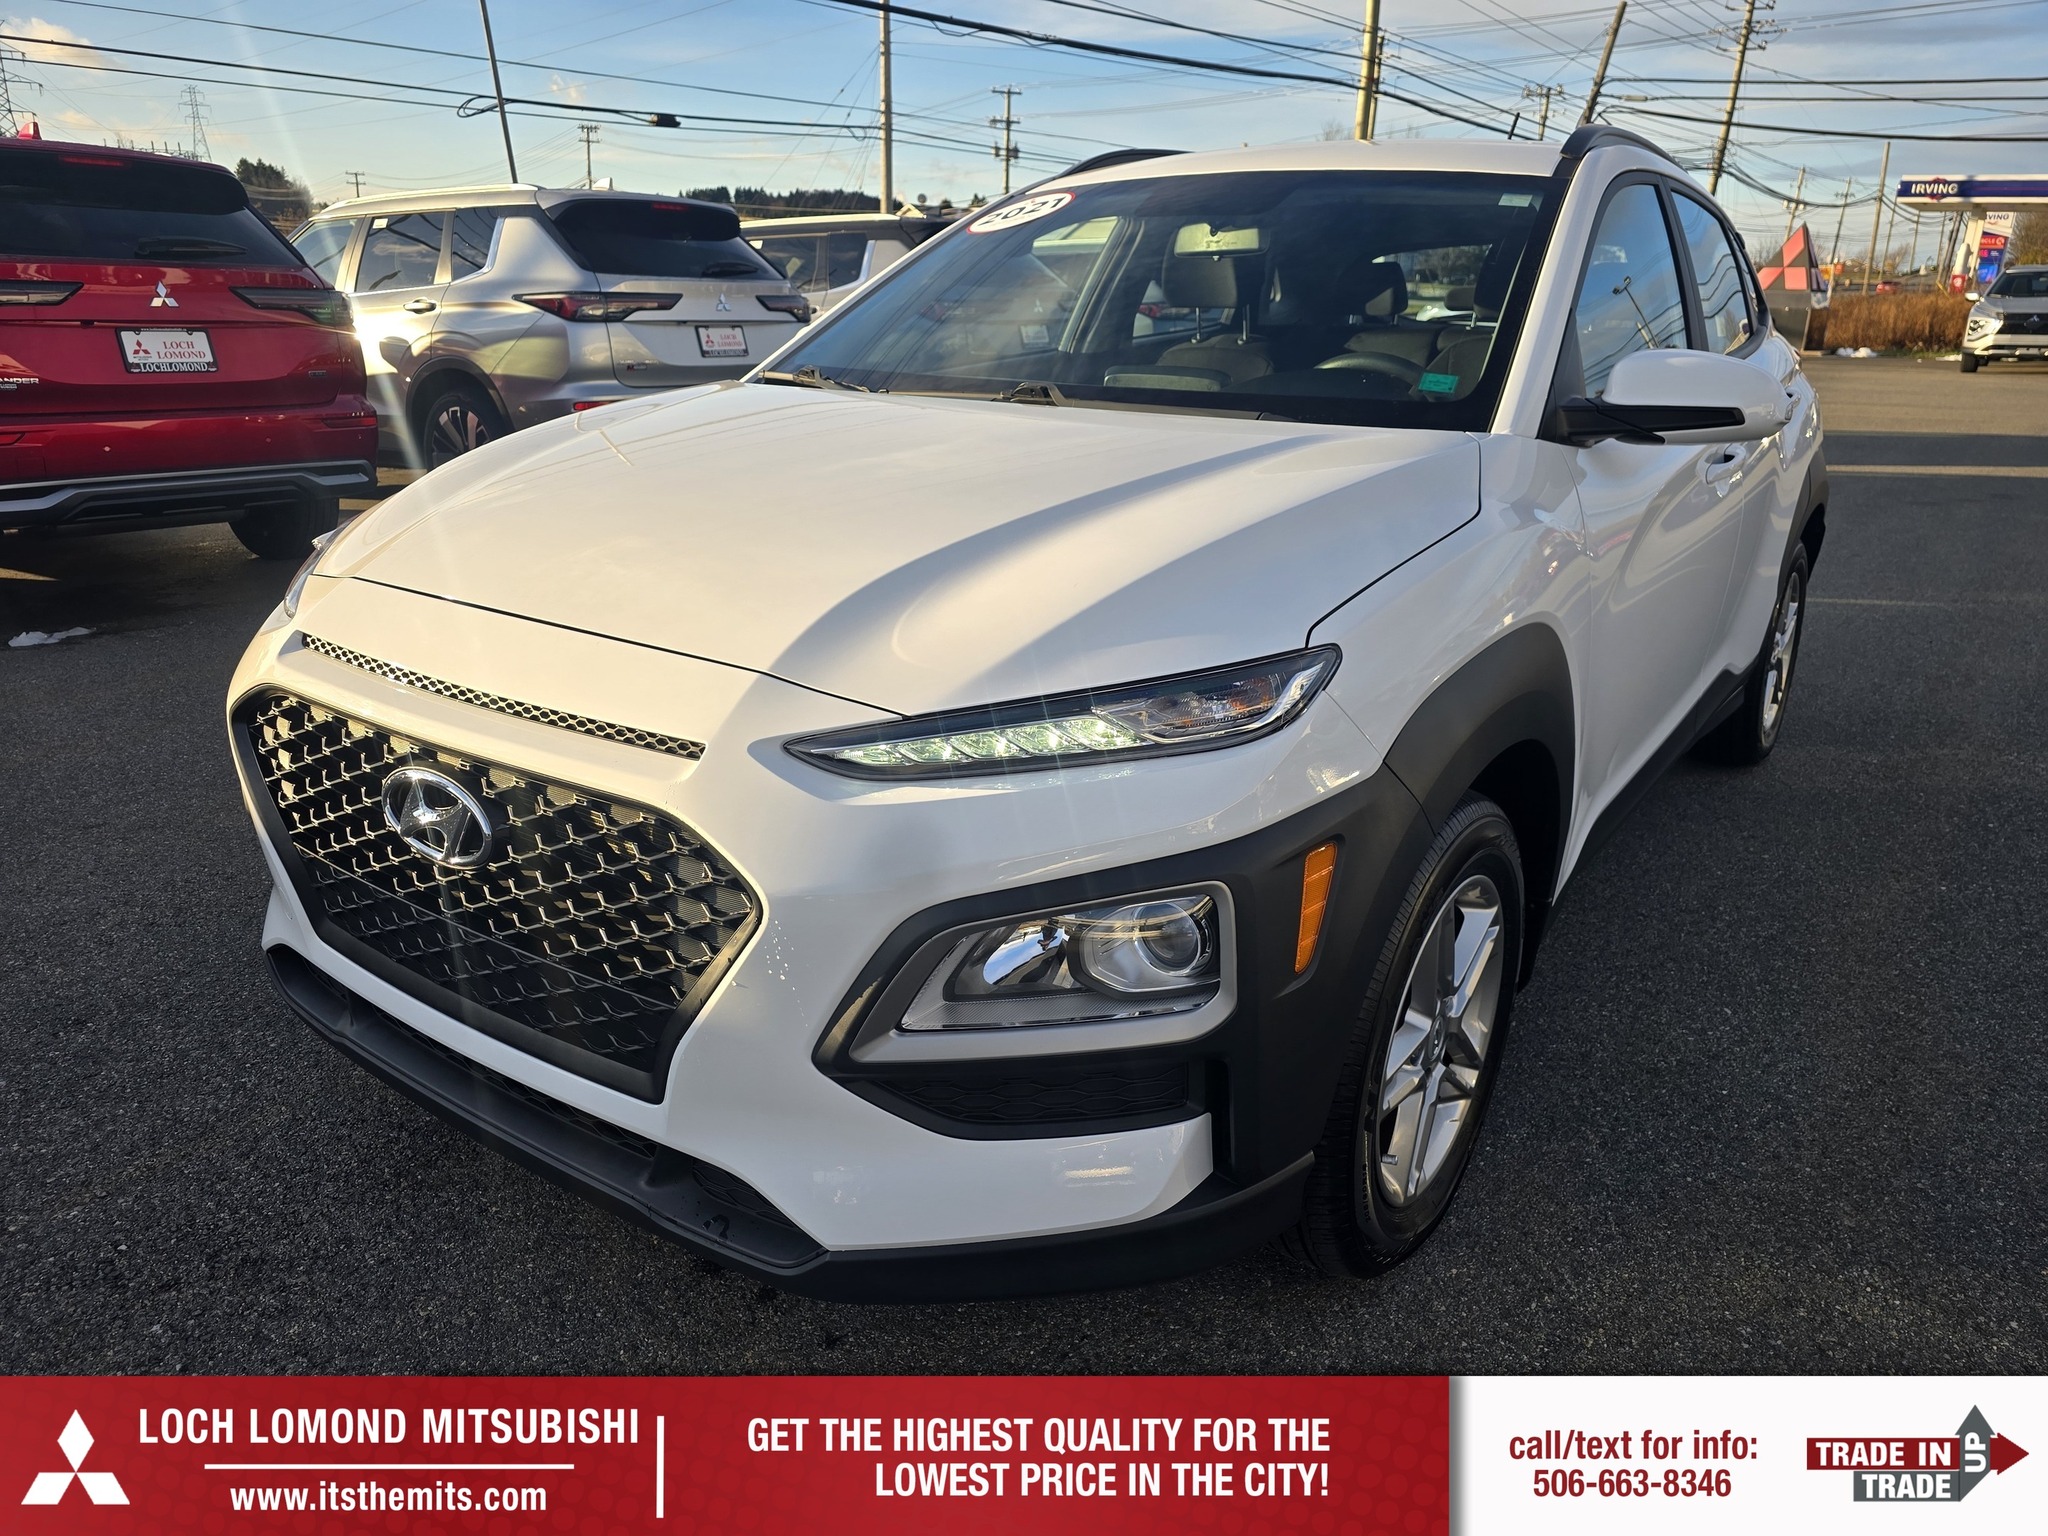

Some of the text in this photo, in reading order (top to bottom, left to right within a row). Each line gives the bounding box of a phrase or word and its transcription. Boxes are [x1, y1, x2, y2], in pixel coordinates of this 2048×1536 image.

[1911, 183, 1958, 194] IRVING
[977, 196, 1067, 227] 2021
[163, 341, 195, 350] LOCH
[156, 350, 206, 360] LOMOND
[140, 362, 208, 372] LOCHLOMOND
